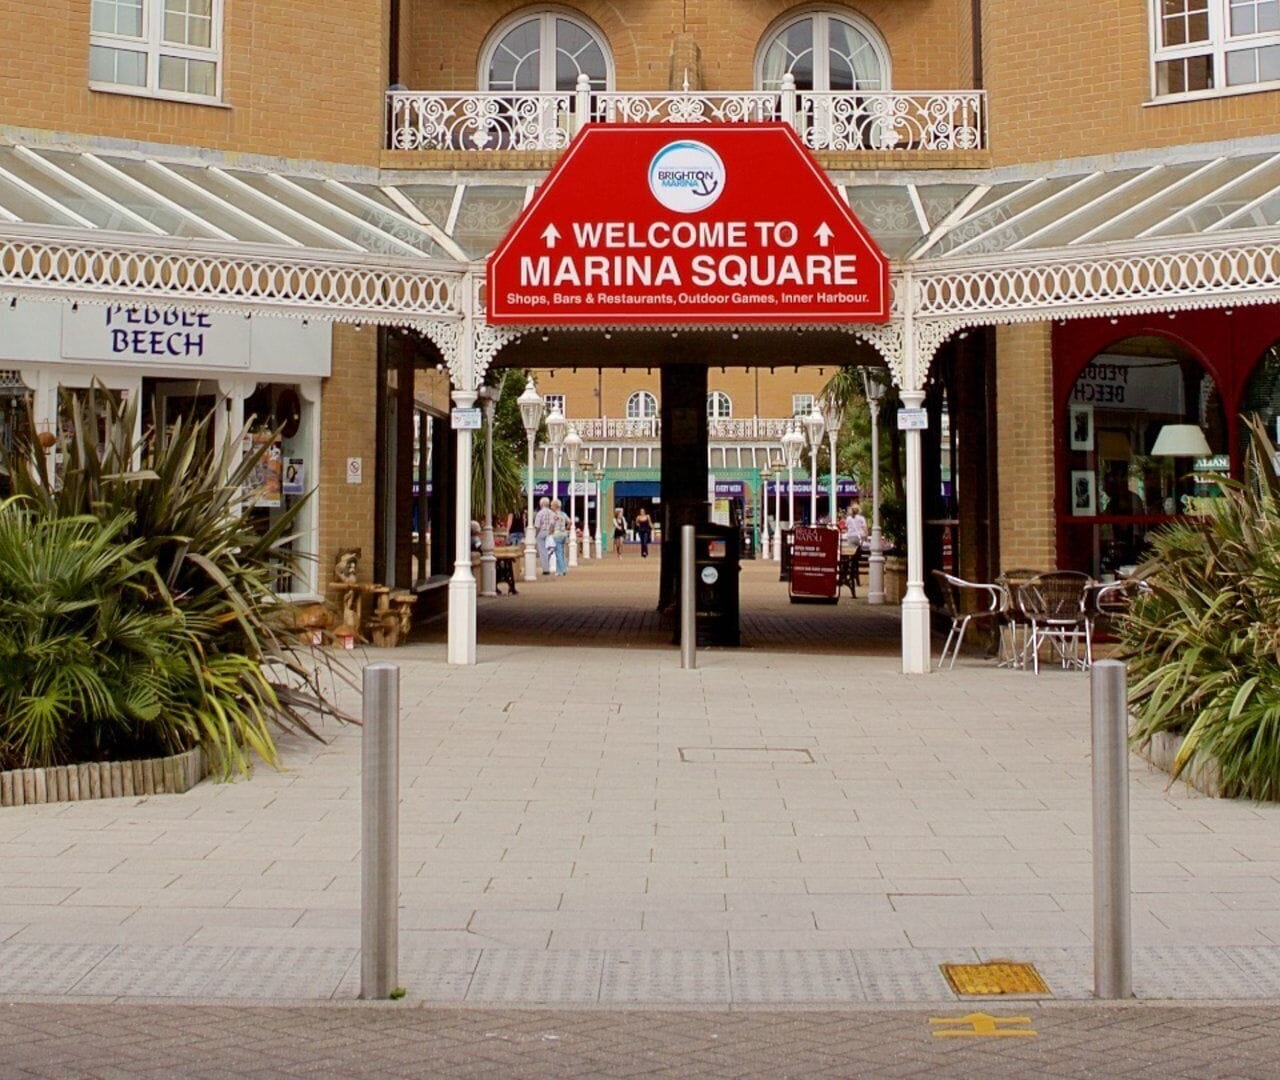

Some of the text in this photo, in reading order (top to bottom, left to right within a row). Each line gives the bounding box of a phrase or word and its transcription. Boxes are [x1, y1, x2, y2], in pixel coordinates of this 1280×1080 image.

[658, 171, 713, 180] BRIGHTON
[572, 221, 798, 248] WELCOME TO
[520, 254, 858, 287] MARINA SQUARE
[507, 292, 870, 307] Shops, Bars & Restaurants, Outdoor Games, Inner Harbour.
[106, 305, 212, 328] PEBBLE
[111, 329, 203, 356] BEECH
